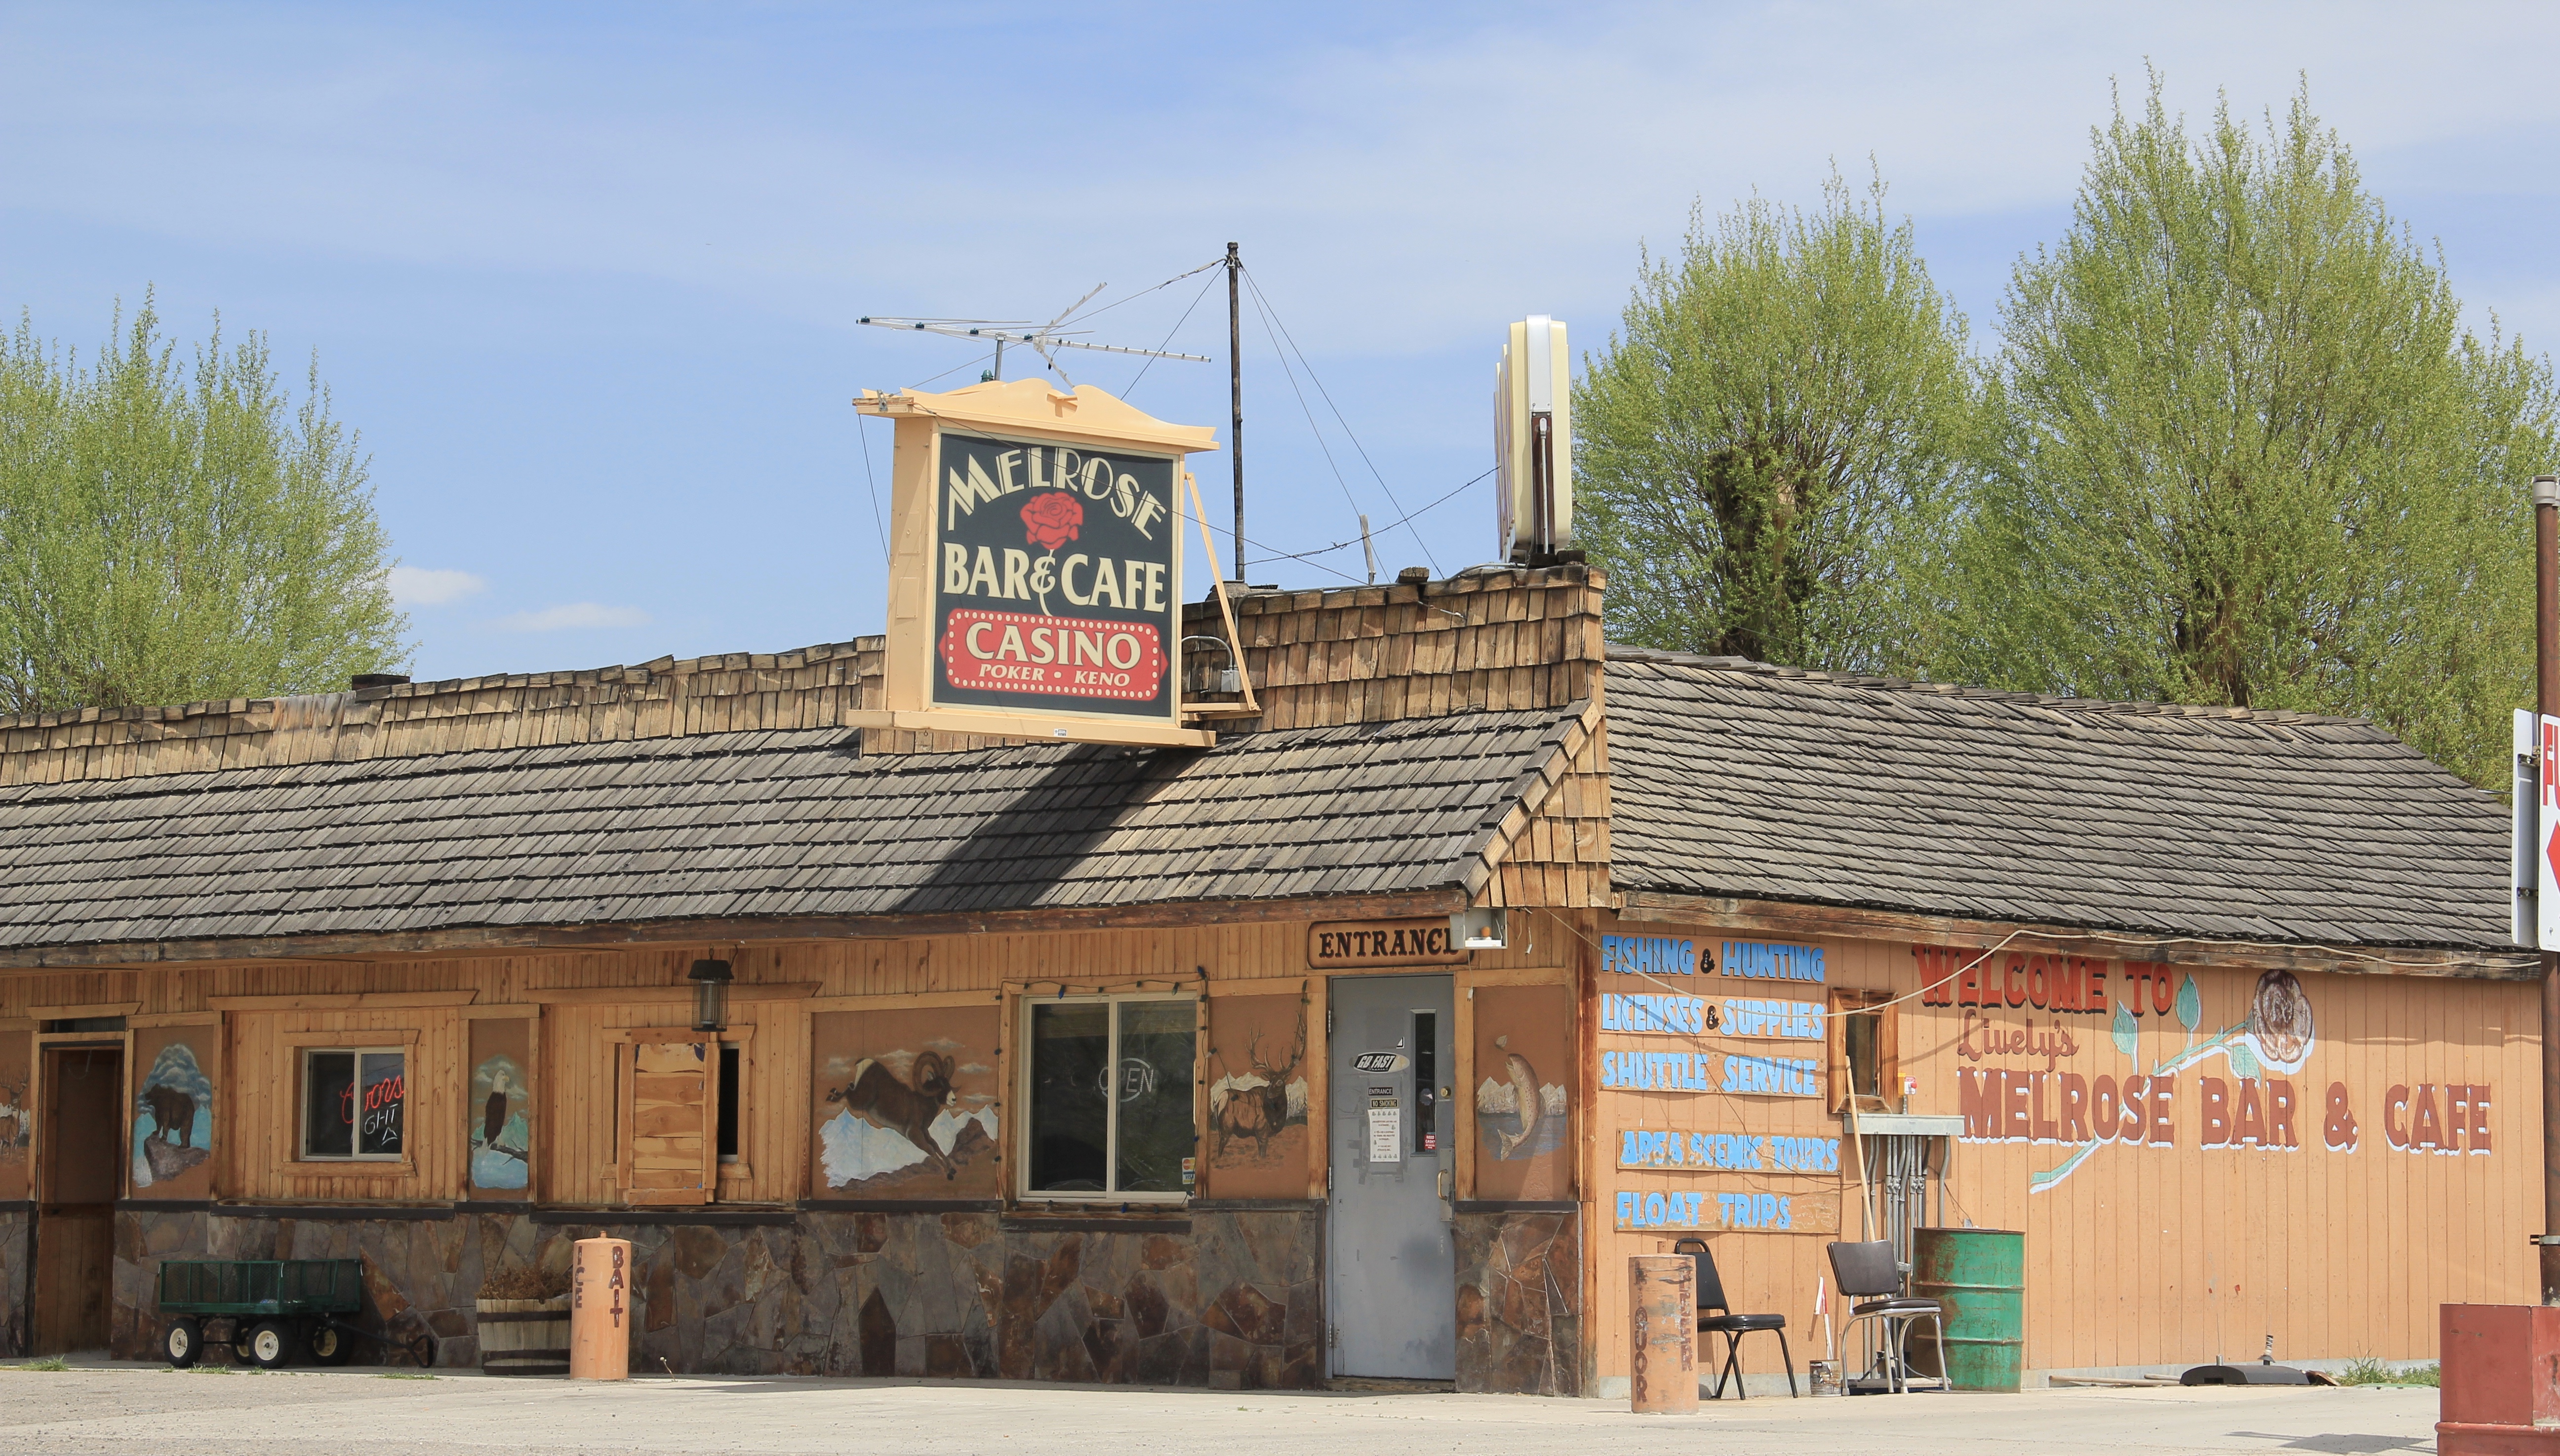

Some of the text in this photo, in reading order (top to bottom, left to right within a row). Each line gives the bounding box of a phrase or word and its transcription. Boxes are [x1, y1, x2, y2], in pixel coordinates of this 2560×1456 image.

[948, 447, 1166, 541] MELROSE
[943, 543, 1166, 613] BAR & CAFE
[965, 622, 1141, 669] CASINO
[979, 664, 1130, 687] POKER KENO
[1601, 935, 1825, 983] FISHING & HUNTING
[1912, 944, 2173, 1017] WELCOME TO
[1602, 993, 1825, 1039] LICENSES & SUPPLIES
[1357, 1056, 1396, 1068] GO FAST
[1957, 1009, 2079, 1072] Lively's
[1602, 1051, 1817, 1095] SHUTTLE SERVICE
[1957, 1066, 2492, 1156] MELROSE BAR & CAFE
[1621, 1131, 1840, 1173] AREA SCENIC TOURS
[1616, 1191, 1792, 1229] FLOAT TRIPS
[575, 1246, 585, 1308] ICE
[608, 1246, 624, 1328] BAIT
